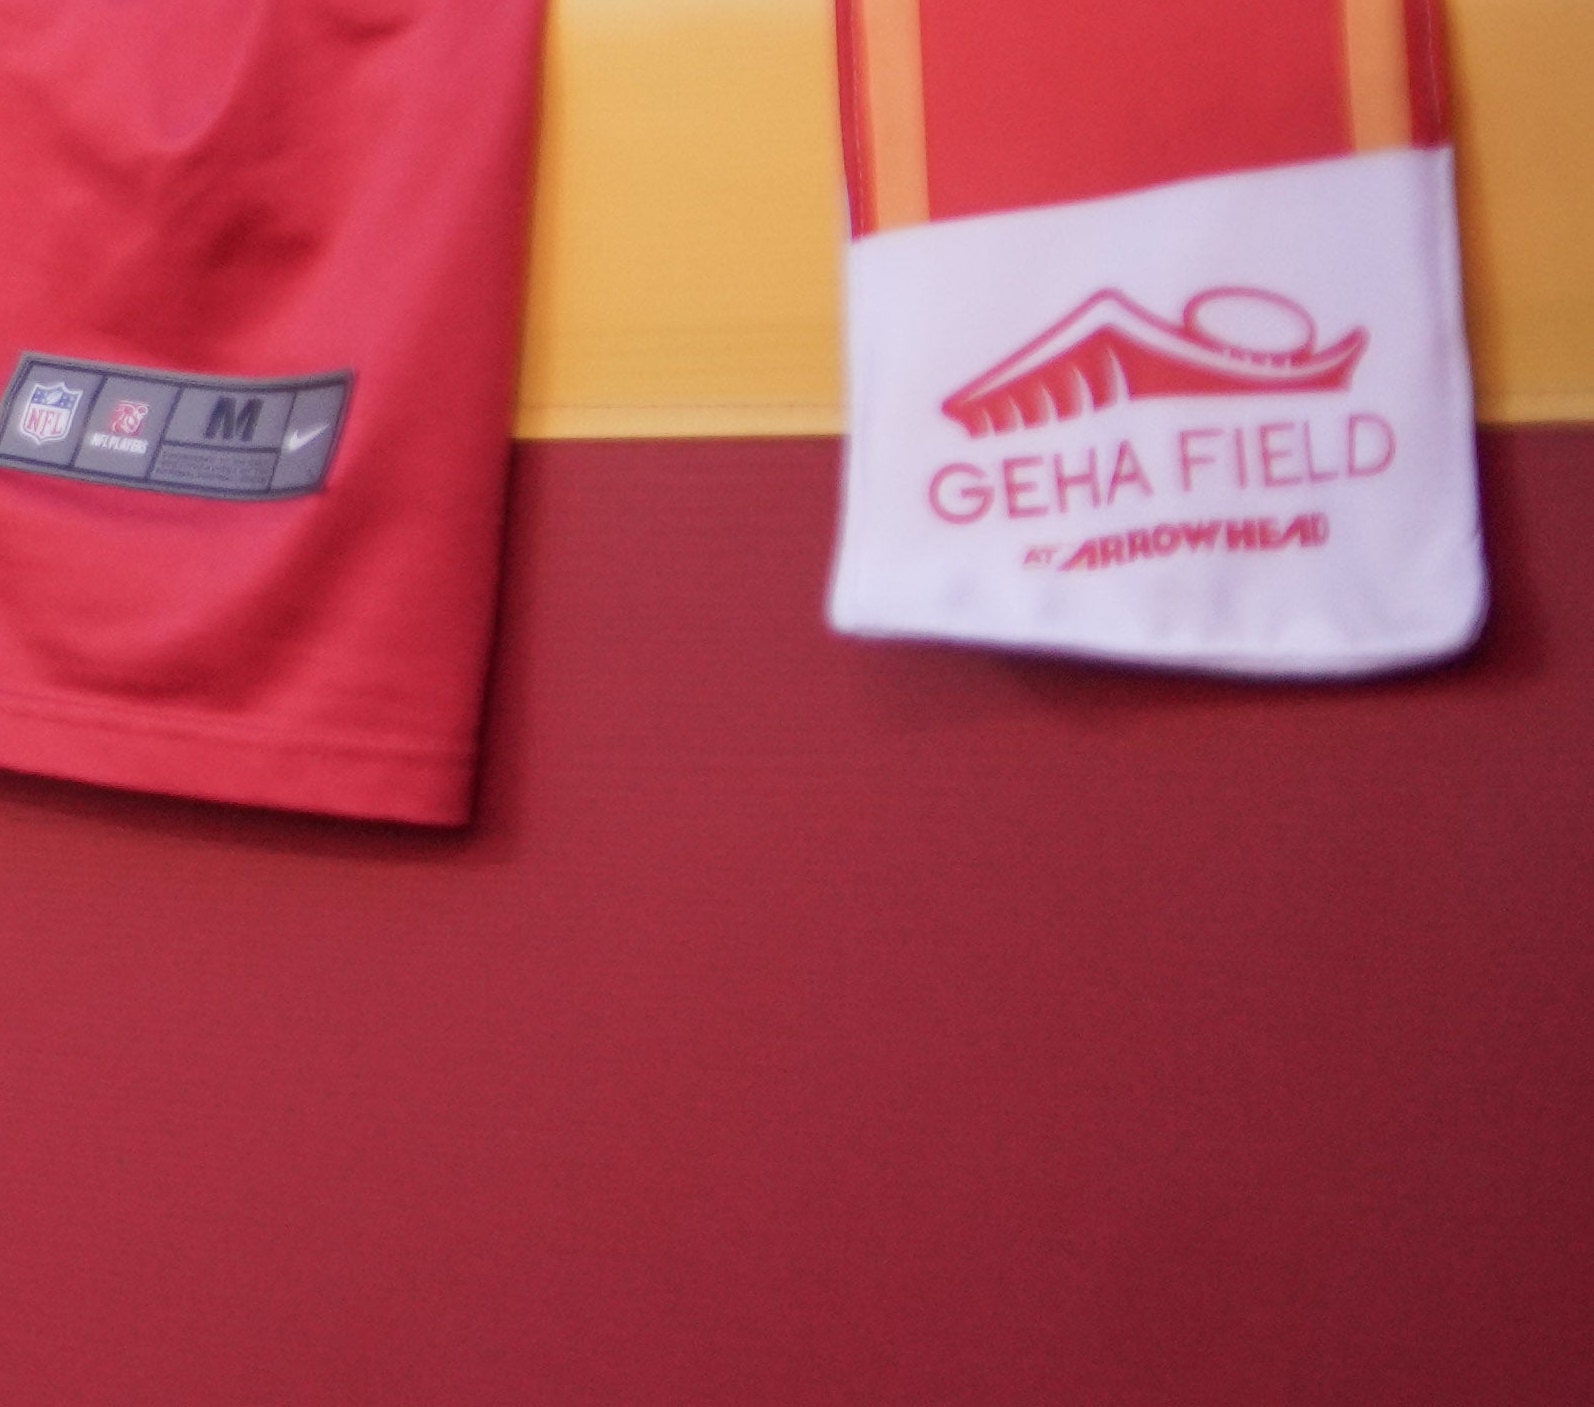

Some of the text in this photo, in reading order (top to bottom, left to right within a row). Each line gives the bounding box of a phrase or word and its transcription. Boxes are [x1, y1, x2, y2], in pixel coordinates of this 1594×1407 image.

[26, 406, 70, 437] NFL
[203, 396, 264, 442] M
[927, 411, 1397, 525] GEHA FIELD
[1021, 511, 1331, 573] AT ARROWHEAD
